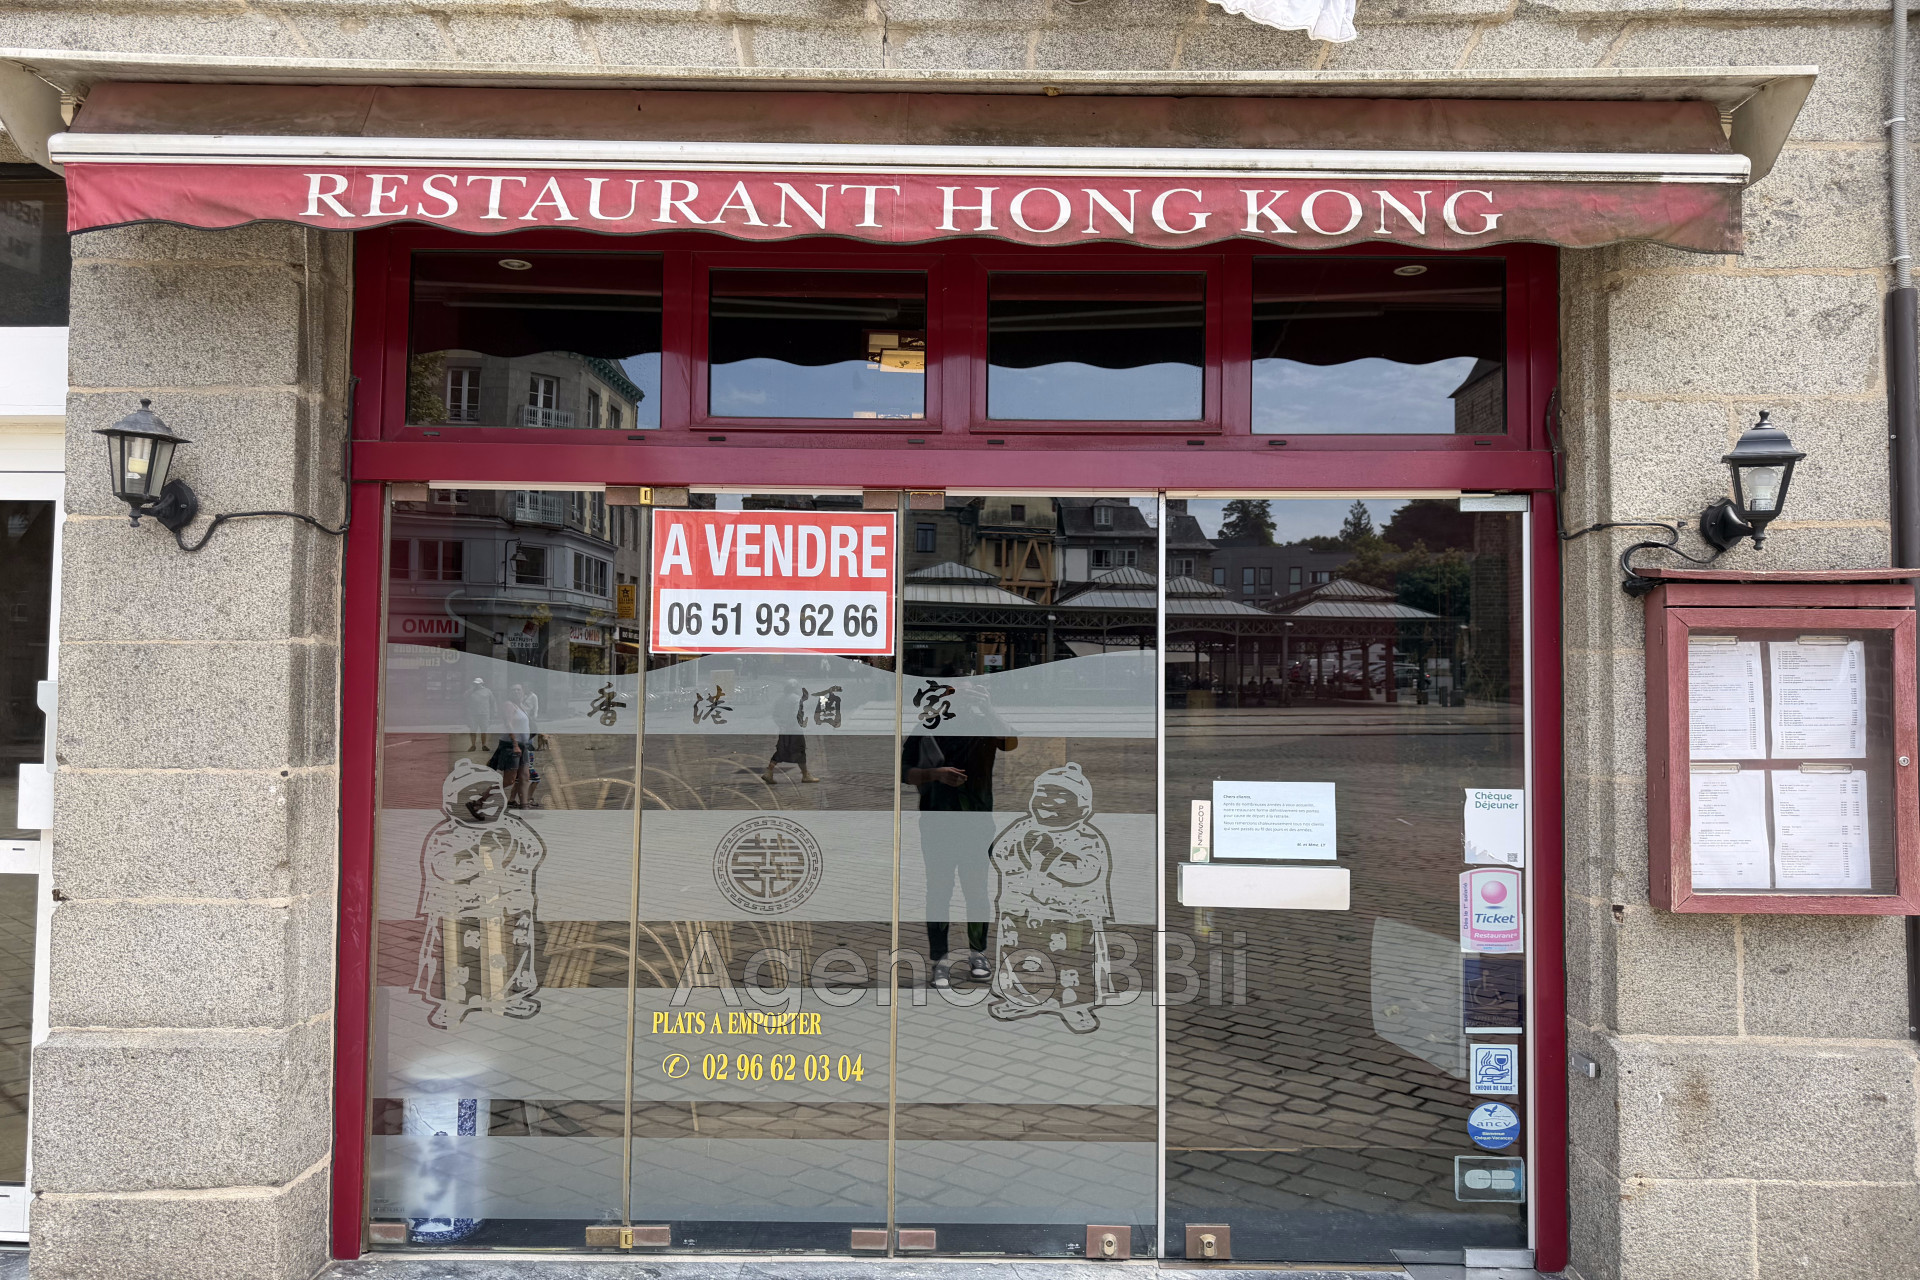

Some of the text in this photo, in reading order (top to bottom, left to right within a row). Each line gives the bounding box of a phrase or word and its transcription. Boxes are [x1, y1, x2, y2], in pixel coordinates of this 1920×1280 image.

[299, 173, 1503, 236] RESTAURANT HONG KONG
[659, 523, 887, 578] A VENDRE
[667, 602, 878, 637] 06 51 93 62 66
[587, 680, 957, 730] 香港酒家
[1475, 791, 1512, 801] Chèque
[1475, 800, 1519, 810] Déjeuner
[1475, 913, 1515, 924] Ticket
[652, 1011, 822, 1035] PLATS A EMPORTER
[702, 1054, 864, 1082] 02 96 62 03 04
